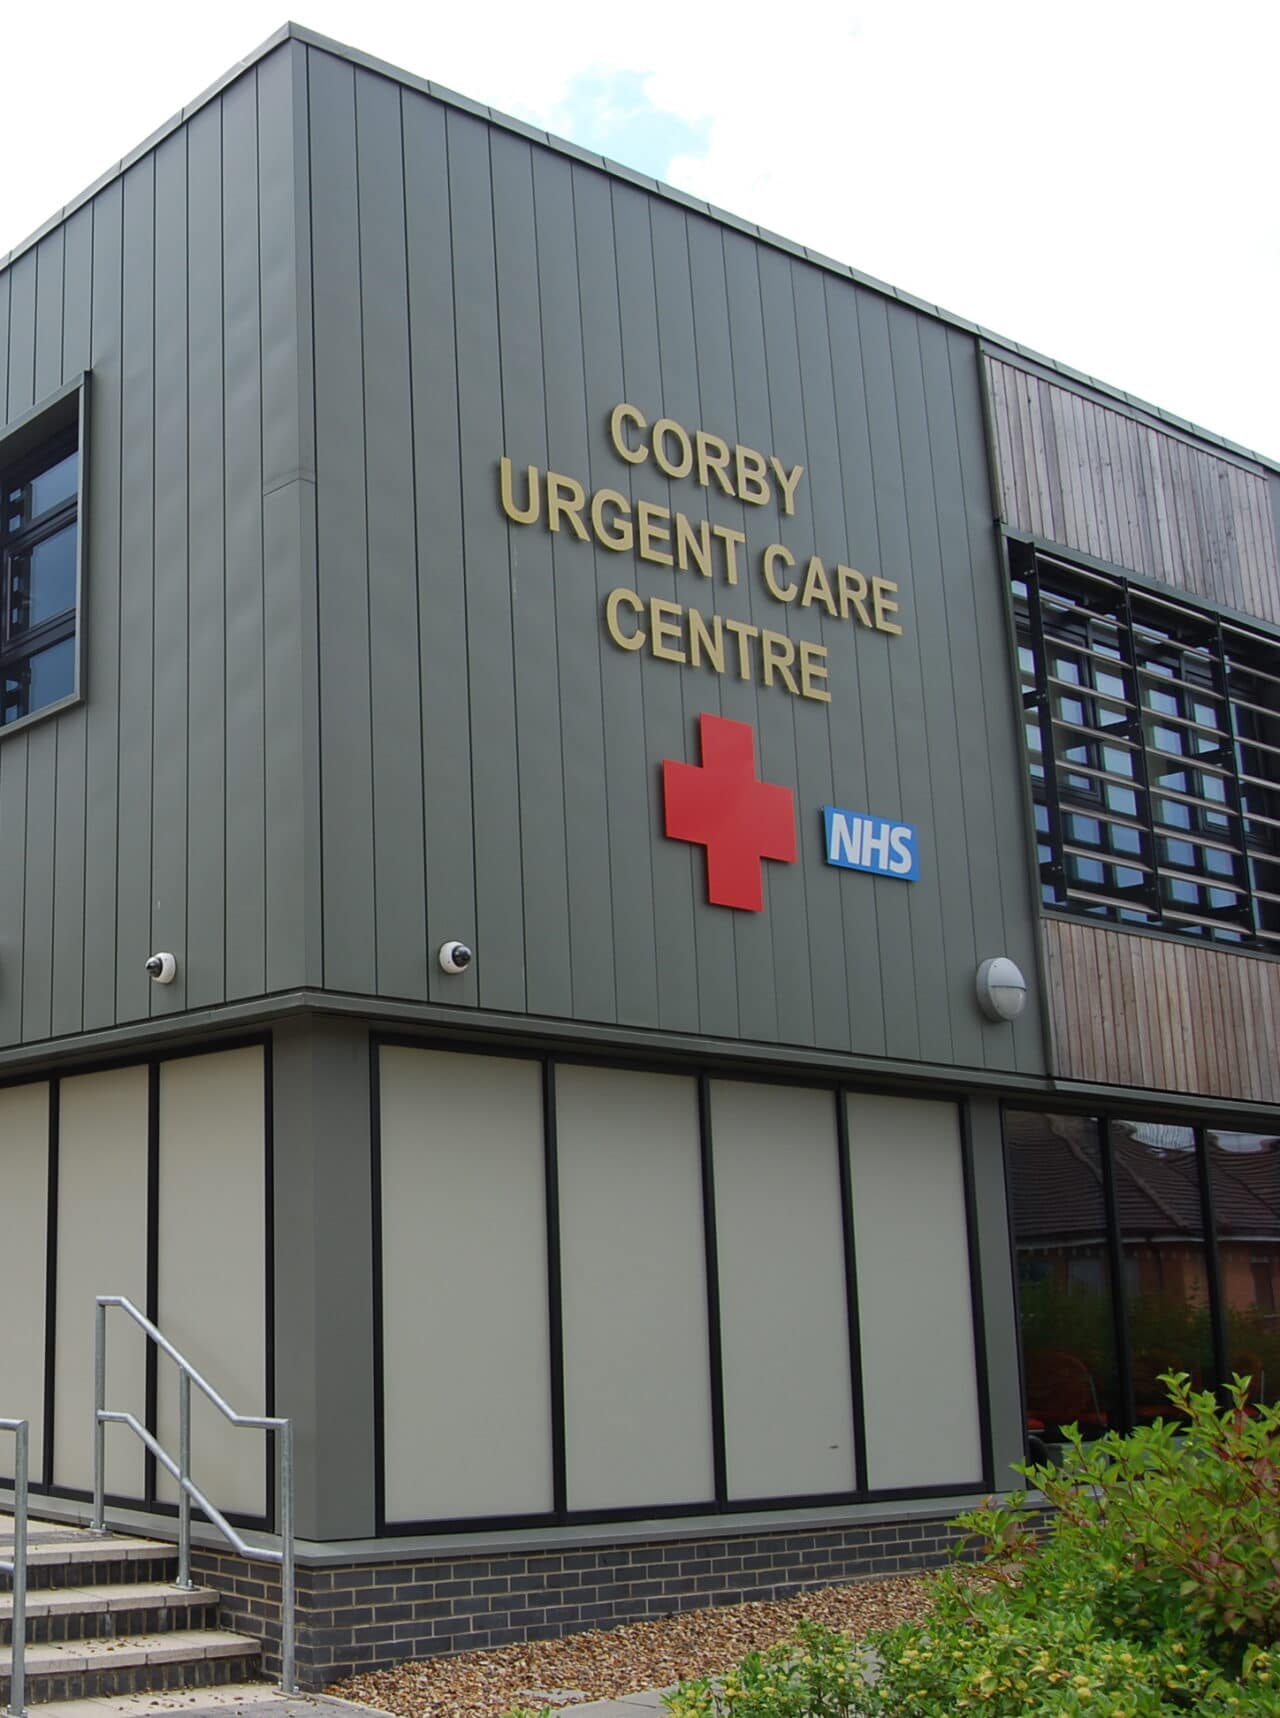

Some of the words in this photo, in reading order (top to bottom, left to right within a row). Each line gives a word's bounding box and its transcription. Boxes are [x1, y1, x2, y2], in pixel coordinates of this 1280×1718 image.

[610, 402, 804, 516] CORBY
[500, 456, 746, 585] URGENT
[763, 543, 903, 636] CARE
[606, 587, 832, 702] CENTRE
[830, 812, 913, 875] NHS
